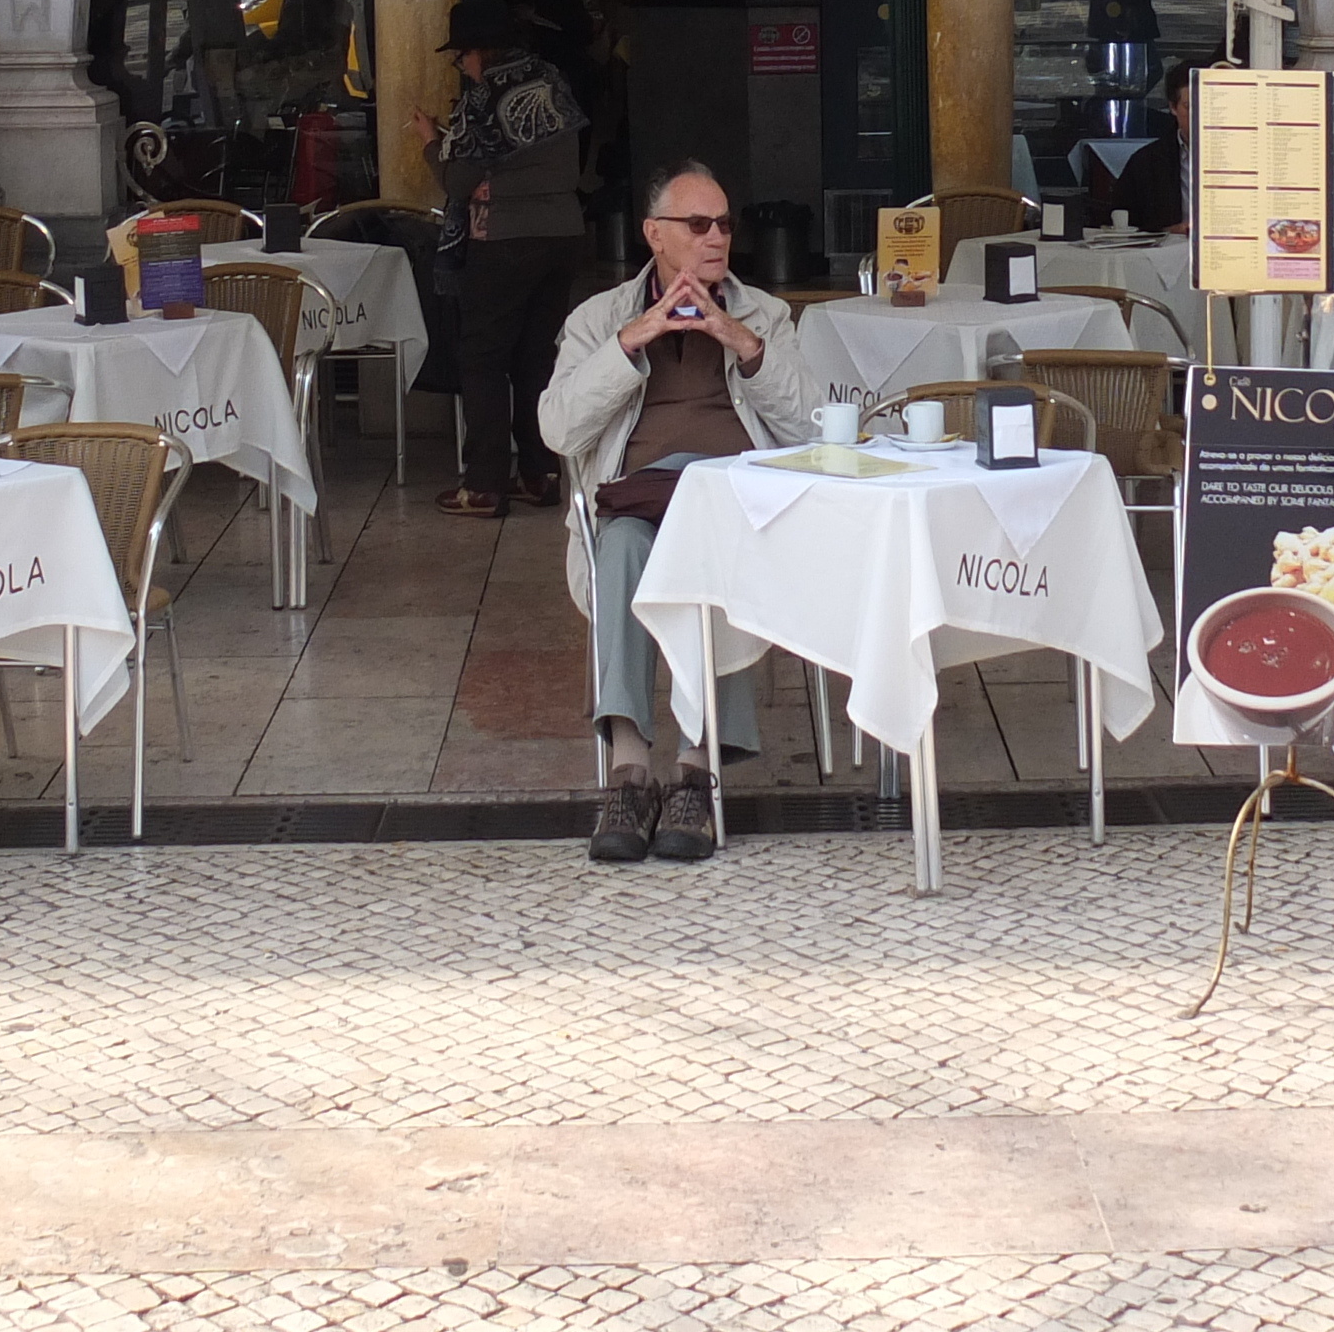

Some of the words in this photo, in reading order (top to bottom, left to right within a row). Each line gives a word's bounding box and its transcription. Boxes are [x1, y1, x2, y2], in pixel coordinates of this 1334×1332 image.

[301, 301, 367, 331] NICOLA
[154, 399, 239, 436] NICOLA
[1201, 481, 1224, 492] DARE
[1227, 481, 1240, 492] TO
[1242, 482, 1267, 493] TASTE
[1268, 483, 1289, 493] OUR
[1267, 495, 1279, 505] BY
[1280, 496, 1306, 507] SOME
[957, 553, 1049, 598] NICOLA
